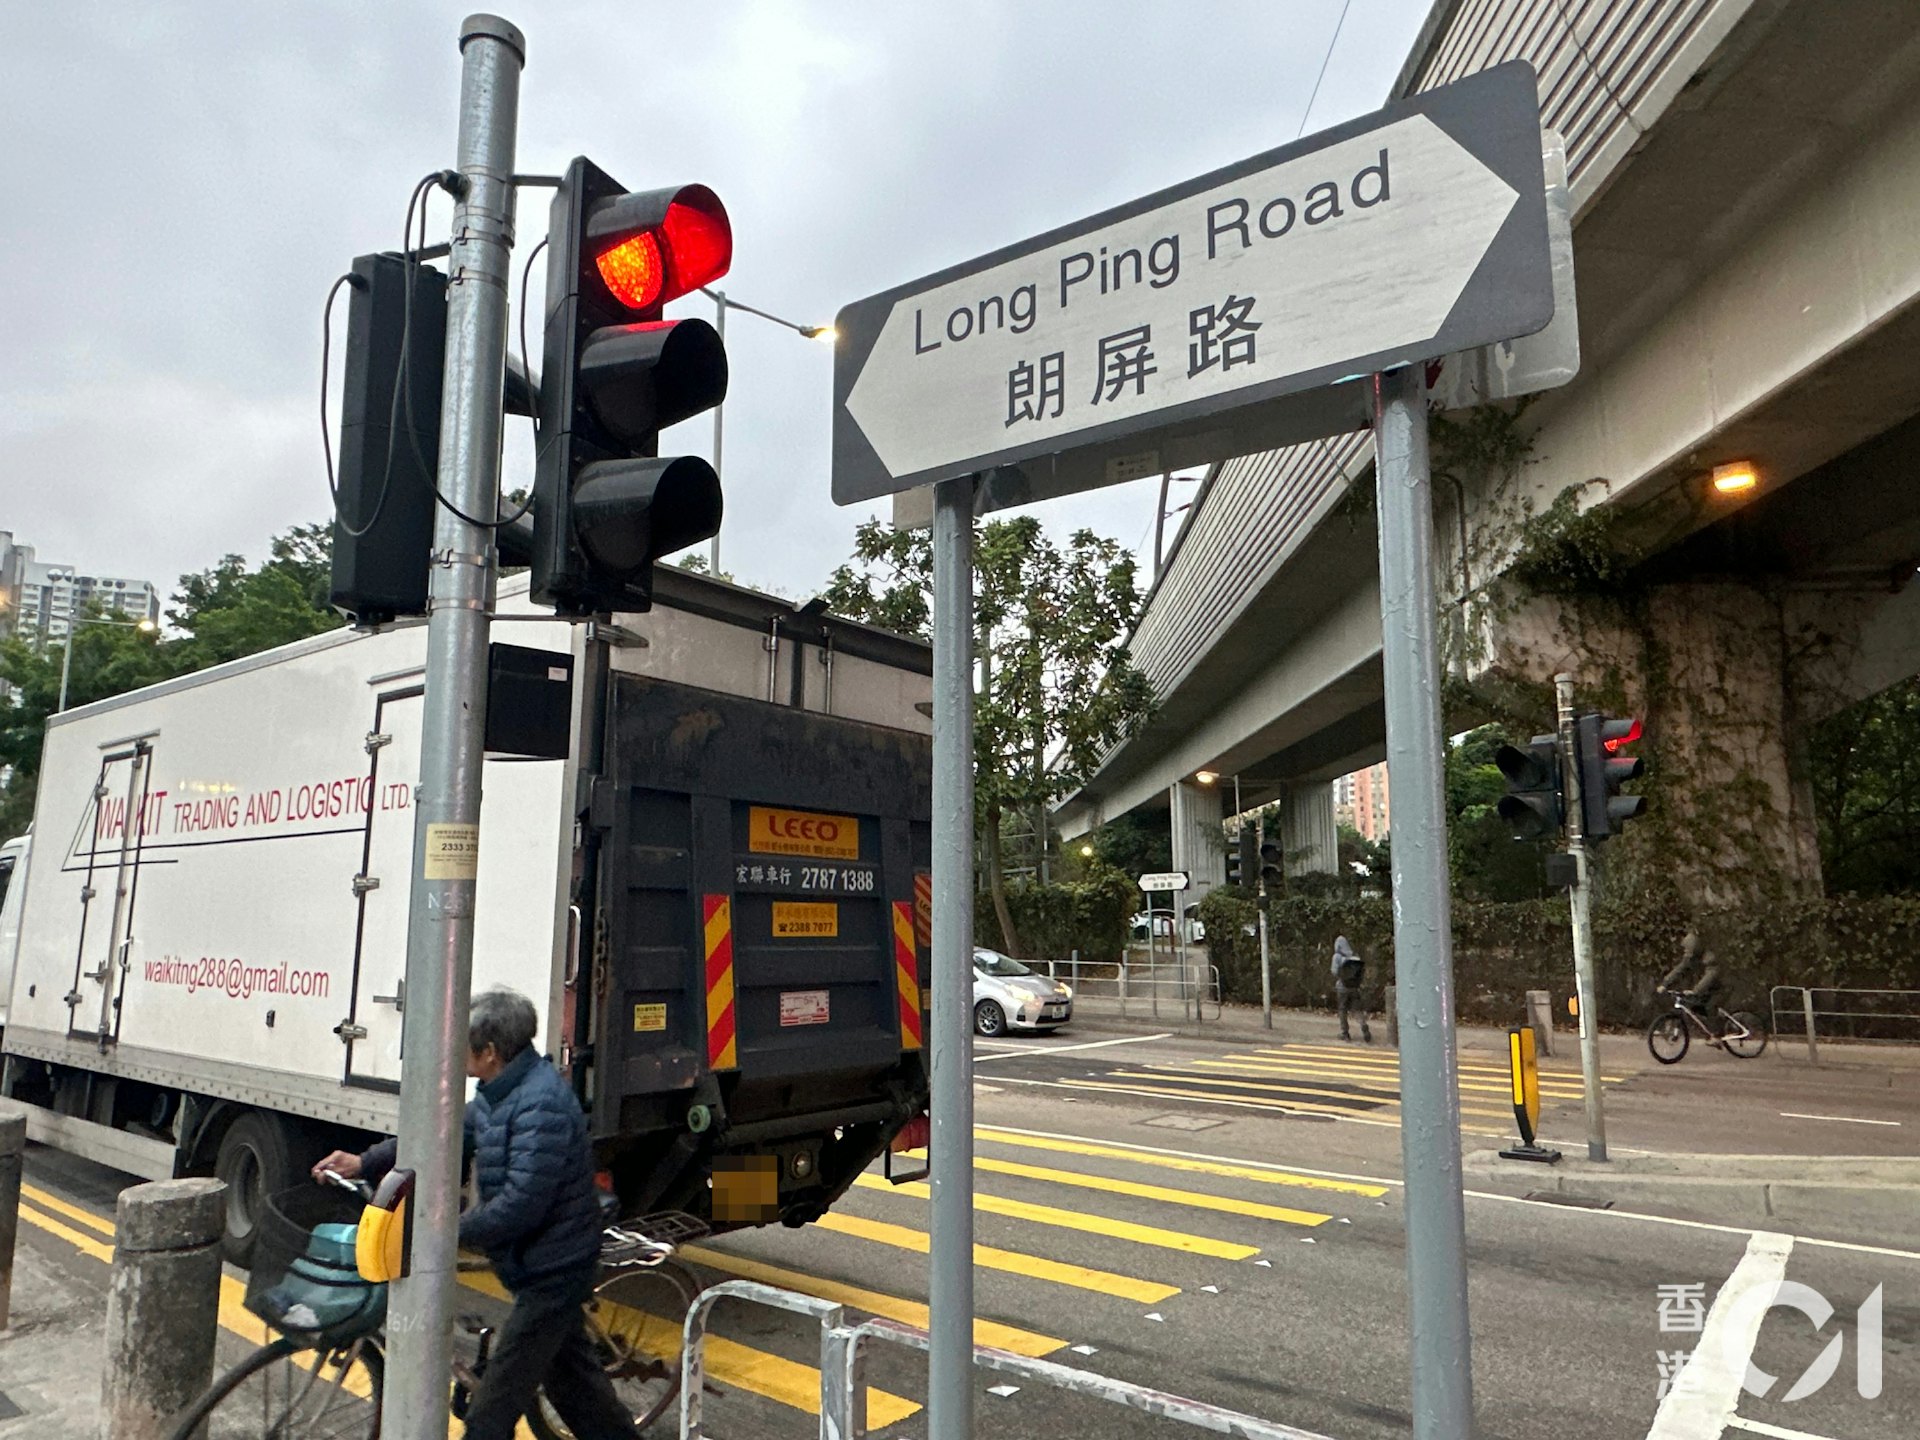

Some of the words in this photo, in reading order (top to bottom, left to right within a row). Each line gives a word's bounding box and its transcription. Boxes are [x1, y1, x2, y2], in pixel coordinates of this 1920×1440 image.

[915, 283, 1036, 355] Long
[1060, 234, 1180, 308] Ping
[1207, 148, 1391, 260] Road
[1004, 294, 1263, 429] 朗屏路
[174, 795, 240, 834] TRADING
[243, 789, 282, 827] AND
[381, 783, 411, 811] LTD.
[441, 842, 464, 852] 2333
[801, 867, 837, 890] 2787
[841, 869, 874, 892] 1388
[144, 954, 330, 999] waikitng288@gmail.com
